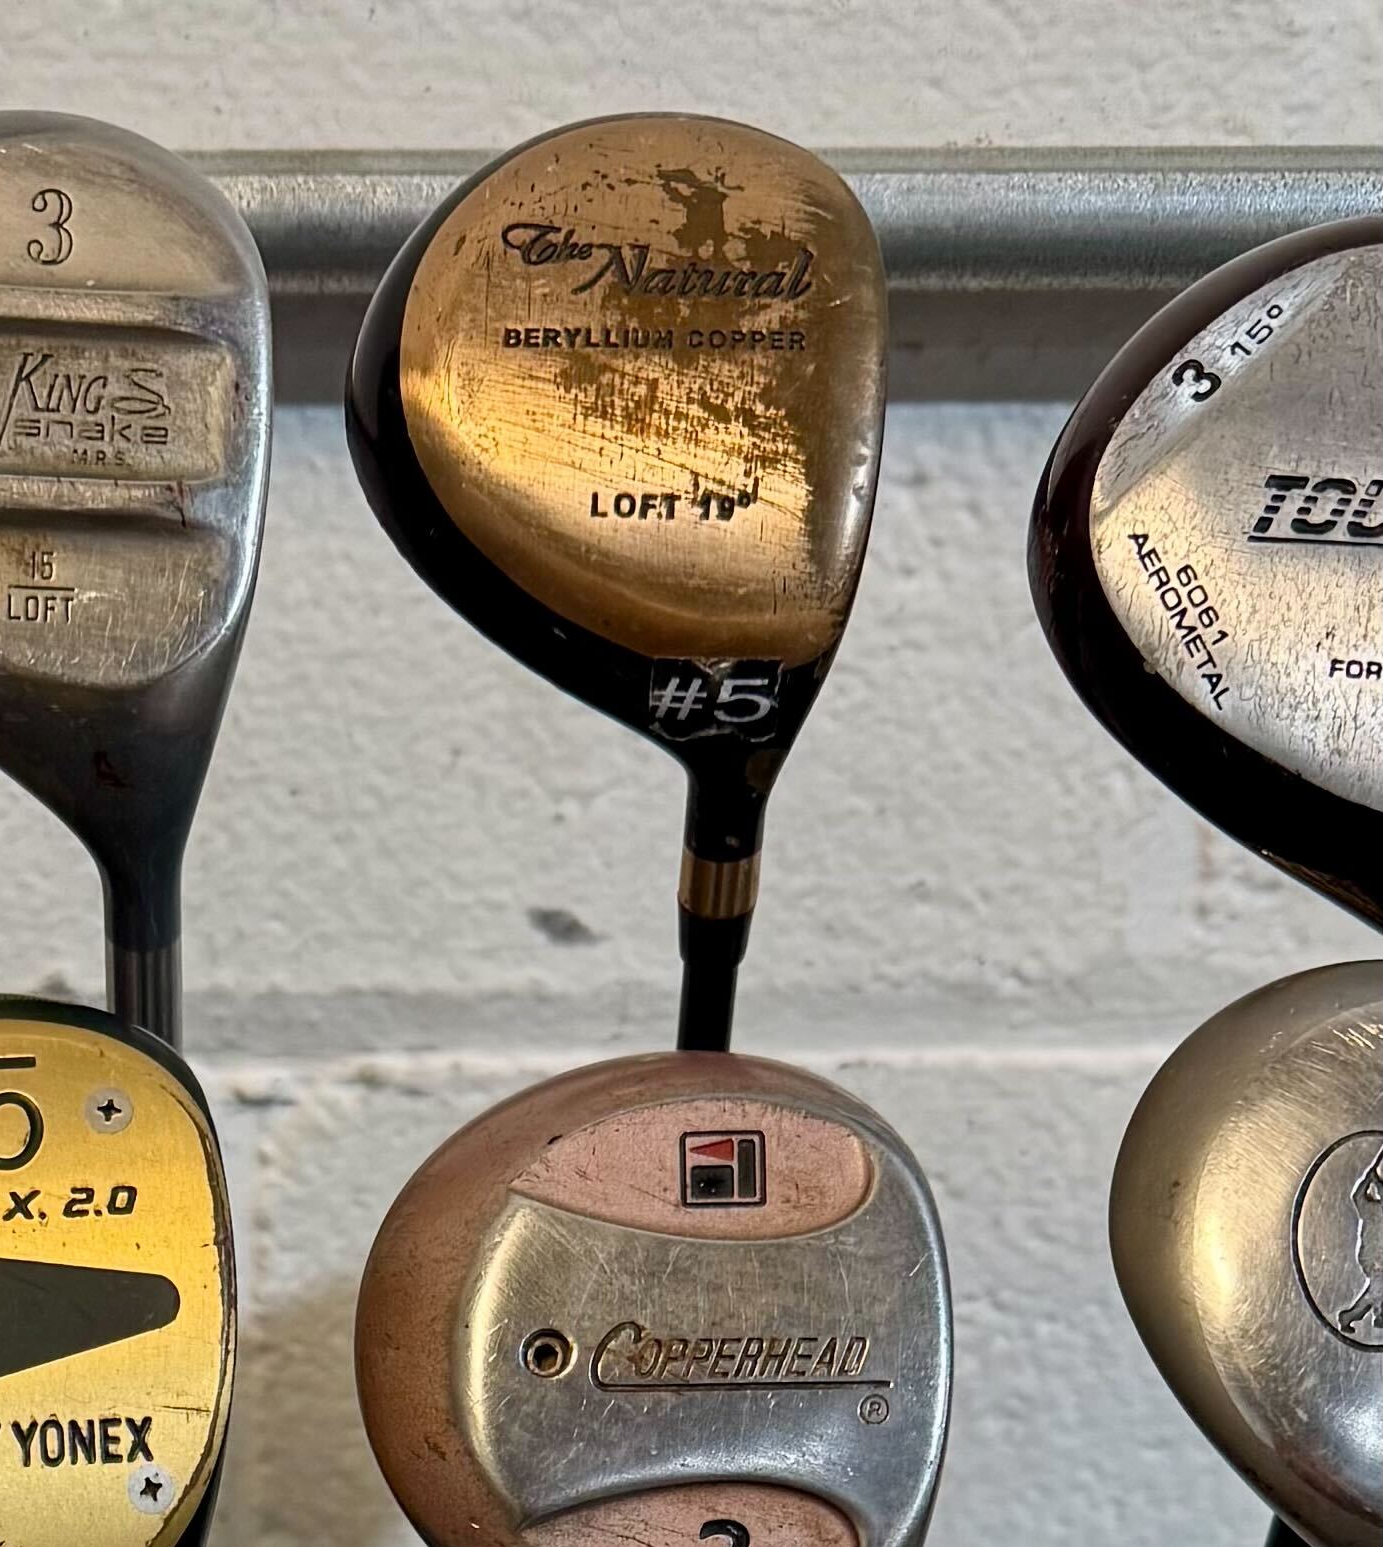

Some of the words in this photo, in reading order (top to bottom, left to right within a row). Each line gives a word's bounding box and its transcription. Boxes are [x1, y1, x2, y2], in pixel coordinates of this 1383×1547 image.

[27, 188, 73, 265] 3
[502, 223, 593, 266] The
[571, 243, 814, 300] Natural
[504, 328, 673, 349] BERYLLIUM
[689, 330, 806, 350] COPPER
[1172, 358, 1223, 403] 3
[590, 491, 681, 520] LOFT
[31, 551, 55, 580] 15
[8, 594, 74, 623] LOFT
[1127, 531, 1231, 711] AEROMETAL
[1176, 564, 1230, 647] 6061
[655, 677, 778, 723] #5
[62, 1185, 137, 1219] 2.0
[589, 1321, 873, 1392] COPPERHEAD
[11, 1416, 154, 1468] YONEX
